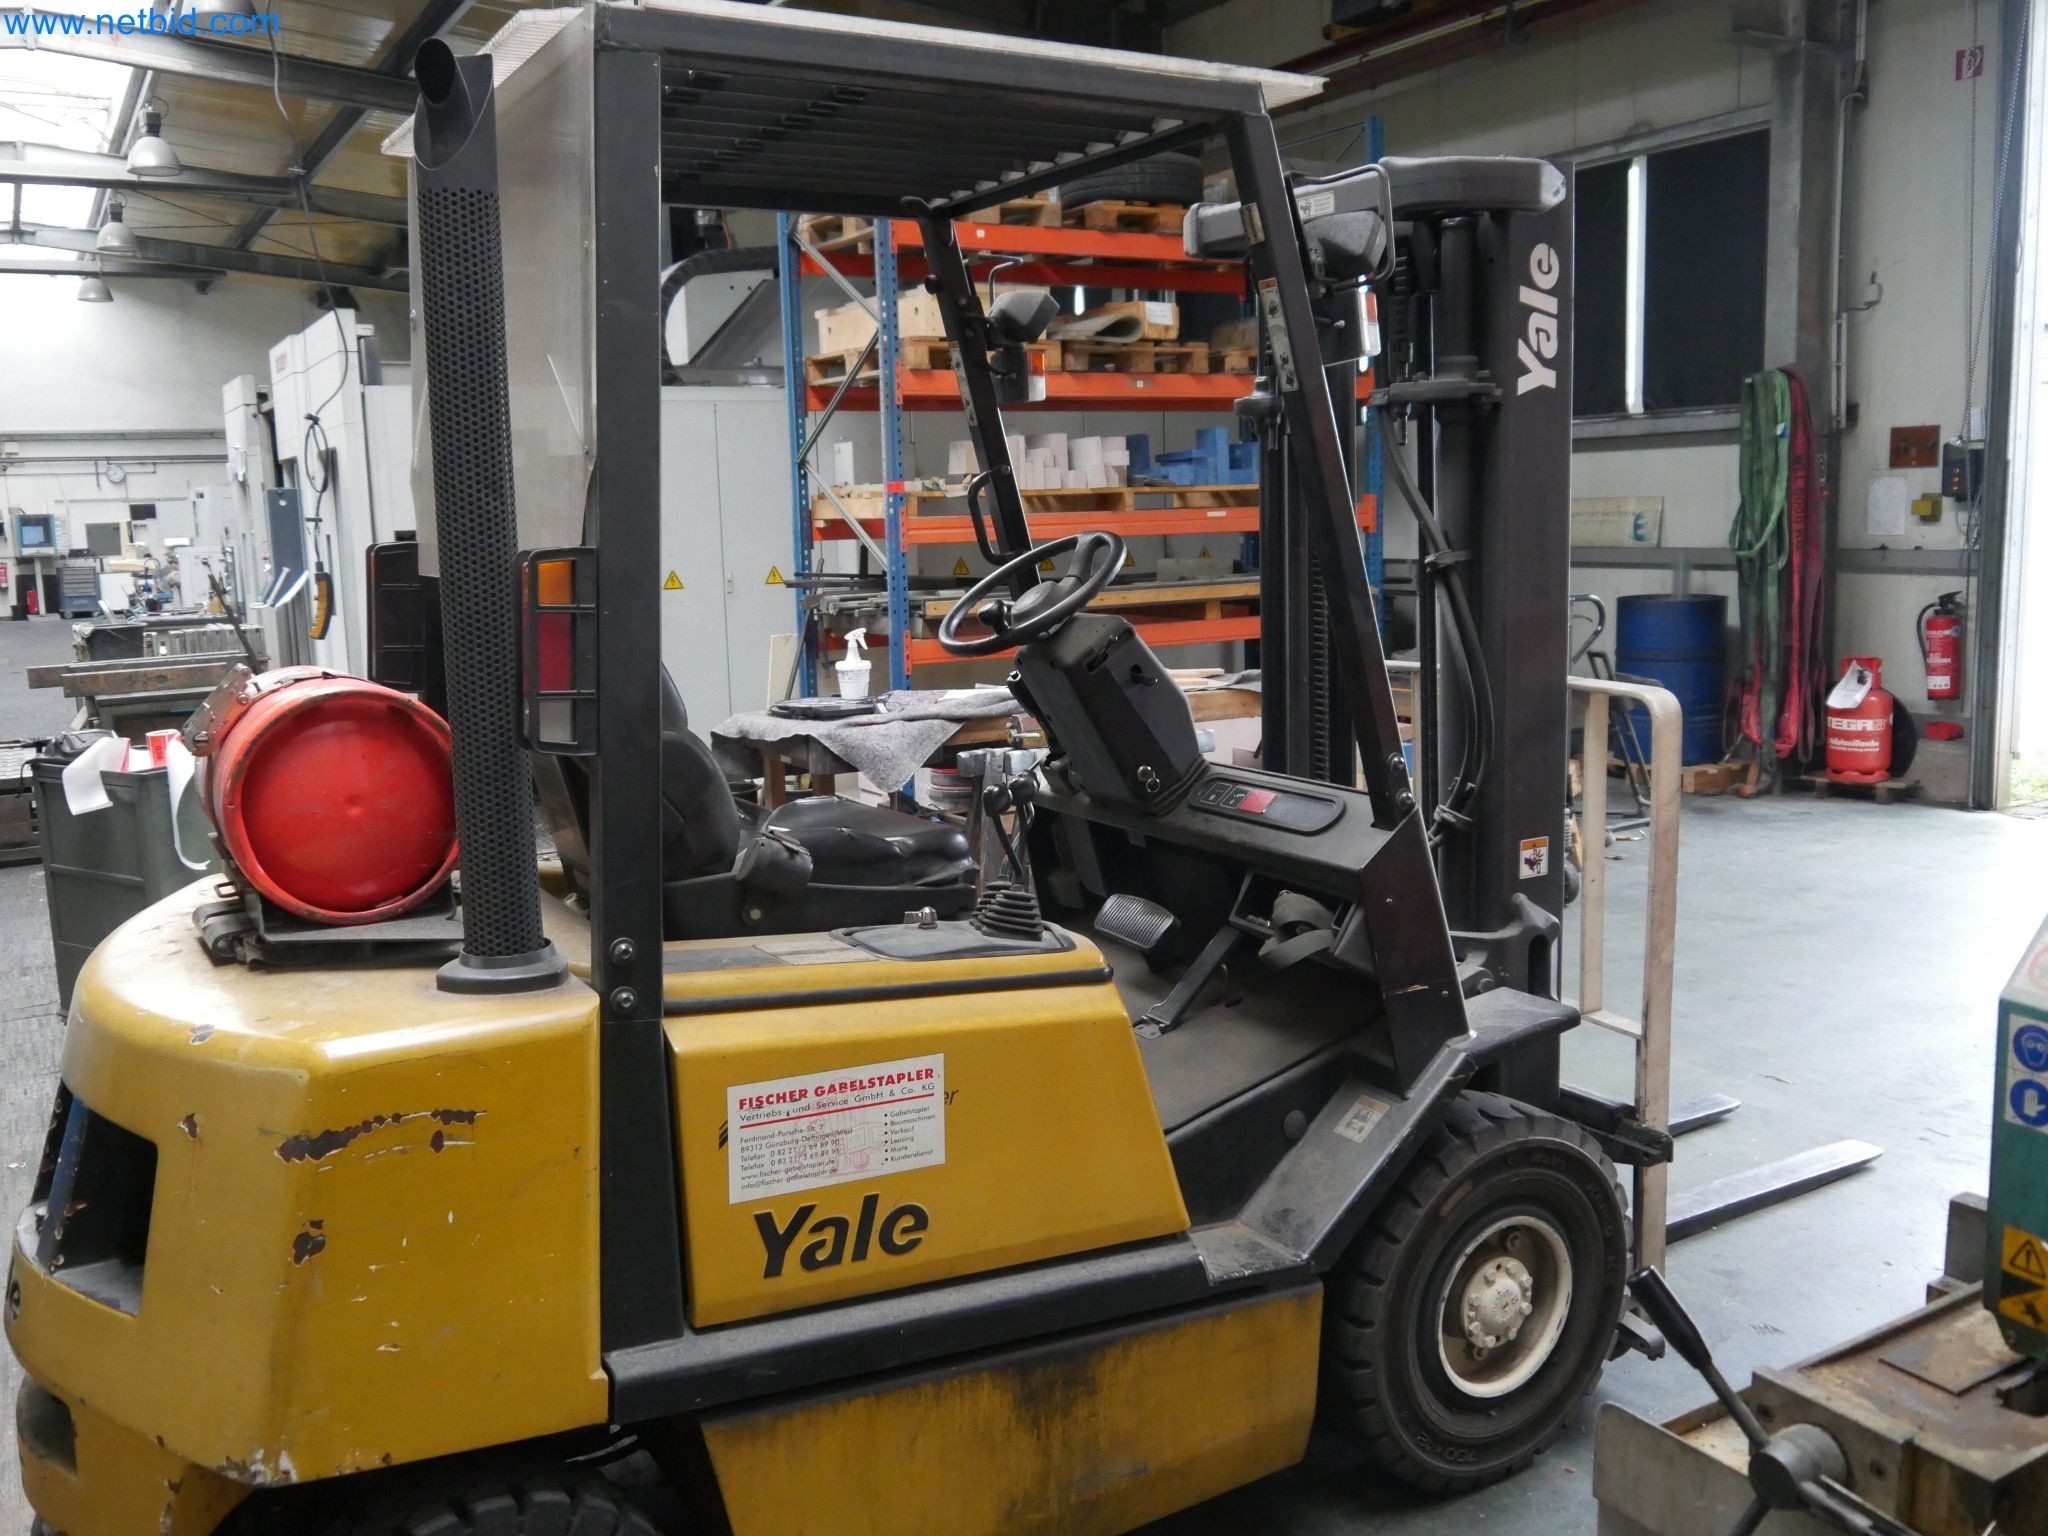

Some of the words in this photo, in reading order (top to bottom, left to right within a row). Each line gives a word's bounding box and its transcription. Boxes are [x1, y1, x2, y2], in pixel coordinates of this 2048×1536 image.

[1518, 243, 1560, 396] Yale
[738, 1088, 808, 1110] FISCHER
[814, 1068, 934, 1098] GABELSTAPLER
[740, 1109, 786, 1121] Vertriebs-
[792, 1103, 810, 1113] und
[816, 1098, 849, 1109] Service
[854, 1091, 883, 1103] GmbH
[889, 1089, 896, 1097] &
[921, 1082, 935, 1092] KG
[890, 1106, 930, 1118] Gabelstapler
[890, 1125, 915, 1135] Verkauf
[890, 1135, 915, 1145] Leasing
[741, 1153, 766, 1163] Telefon
[890, 1149, 933, 1162] Kundendienst
[741, 1163, 765, 1172] Telefax
[753, 1193, 929, 1279] Yale
